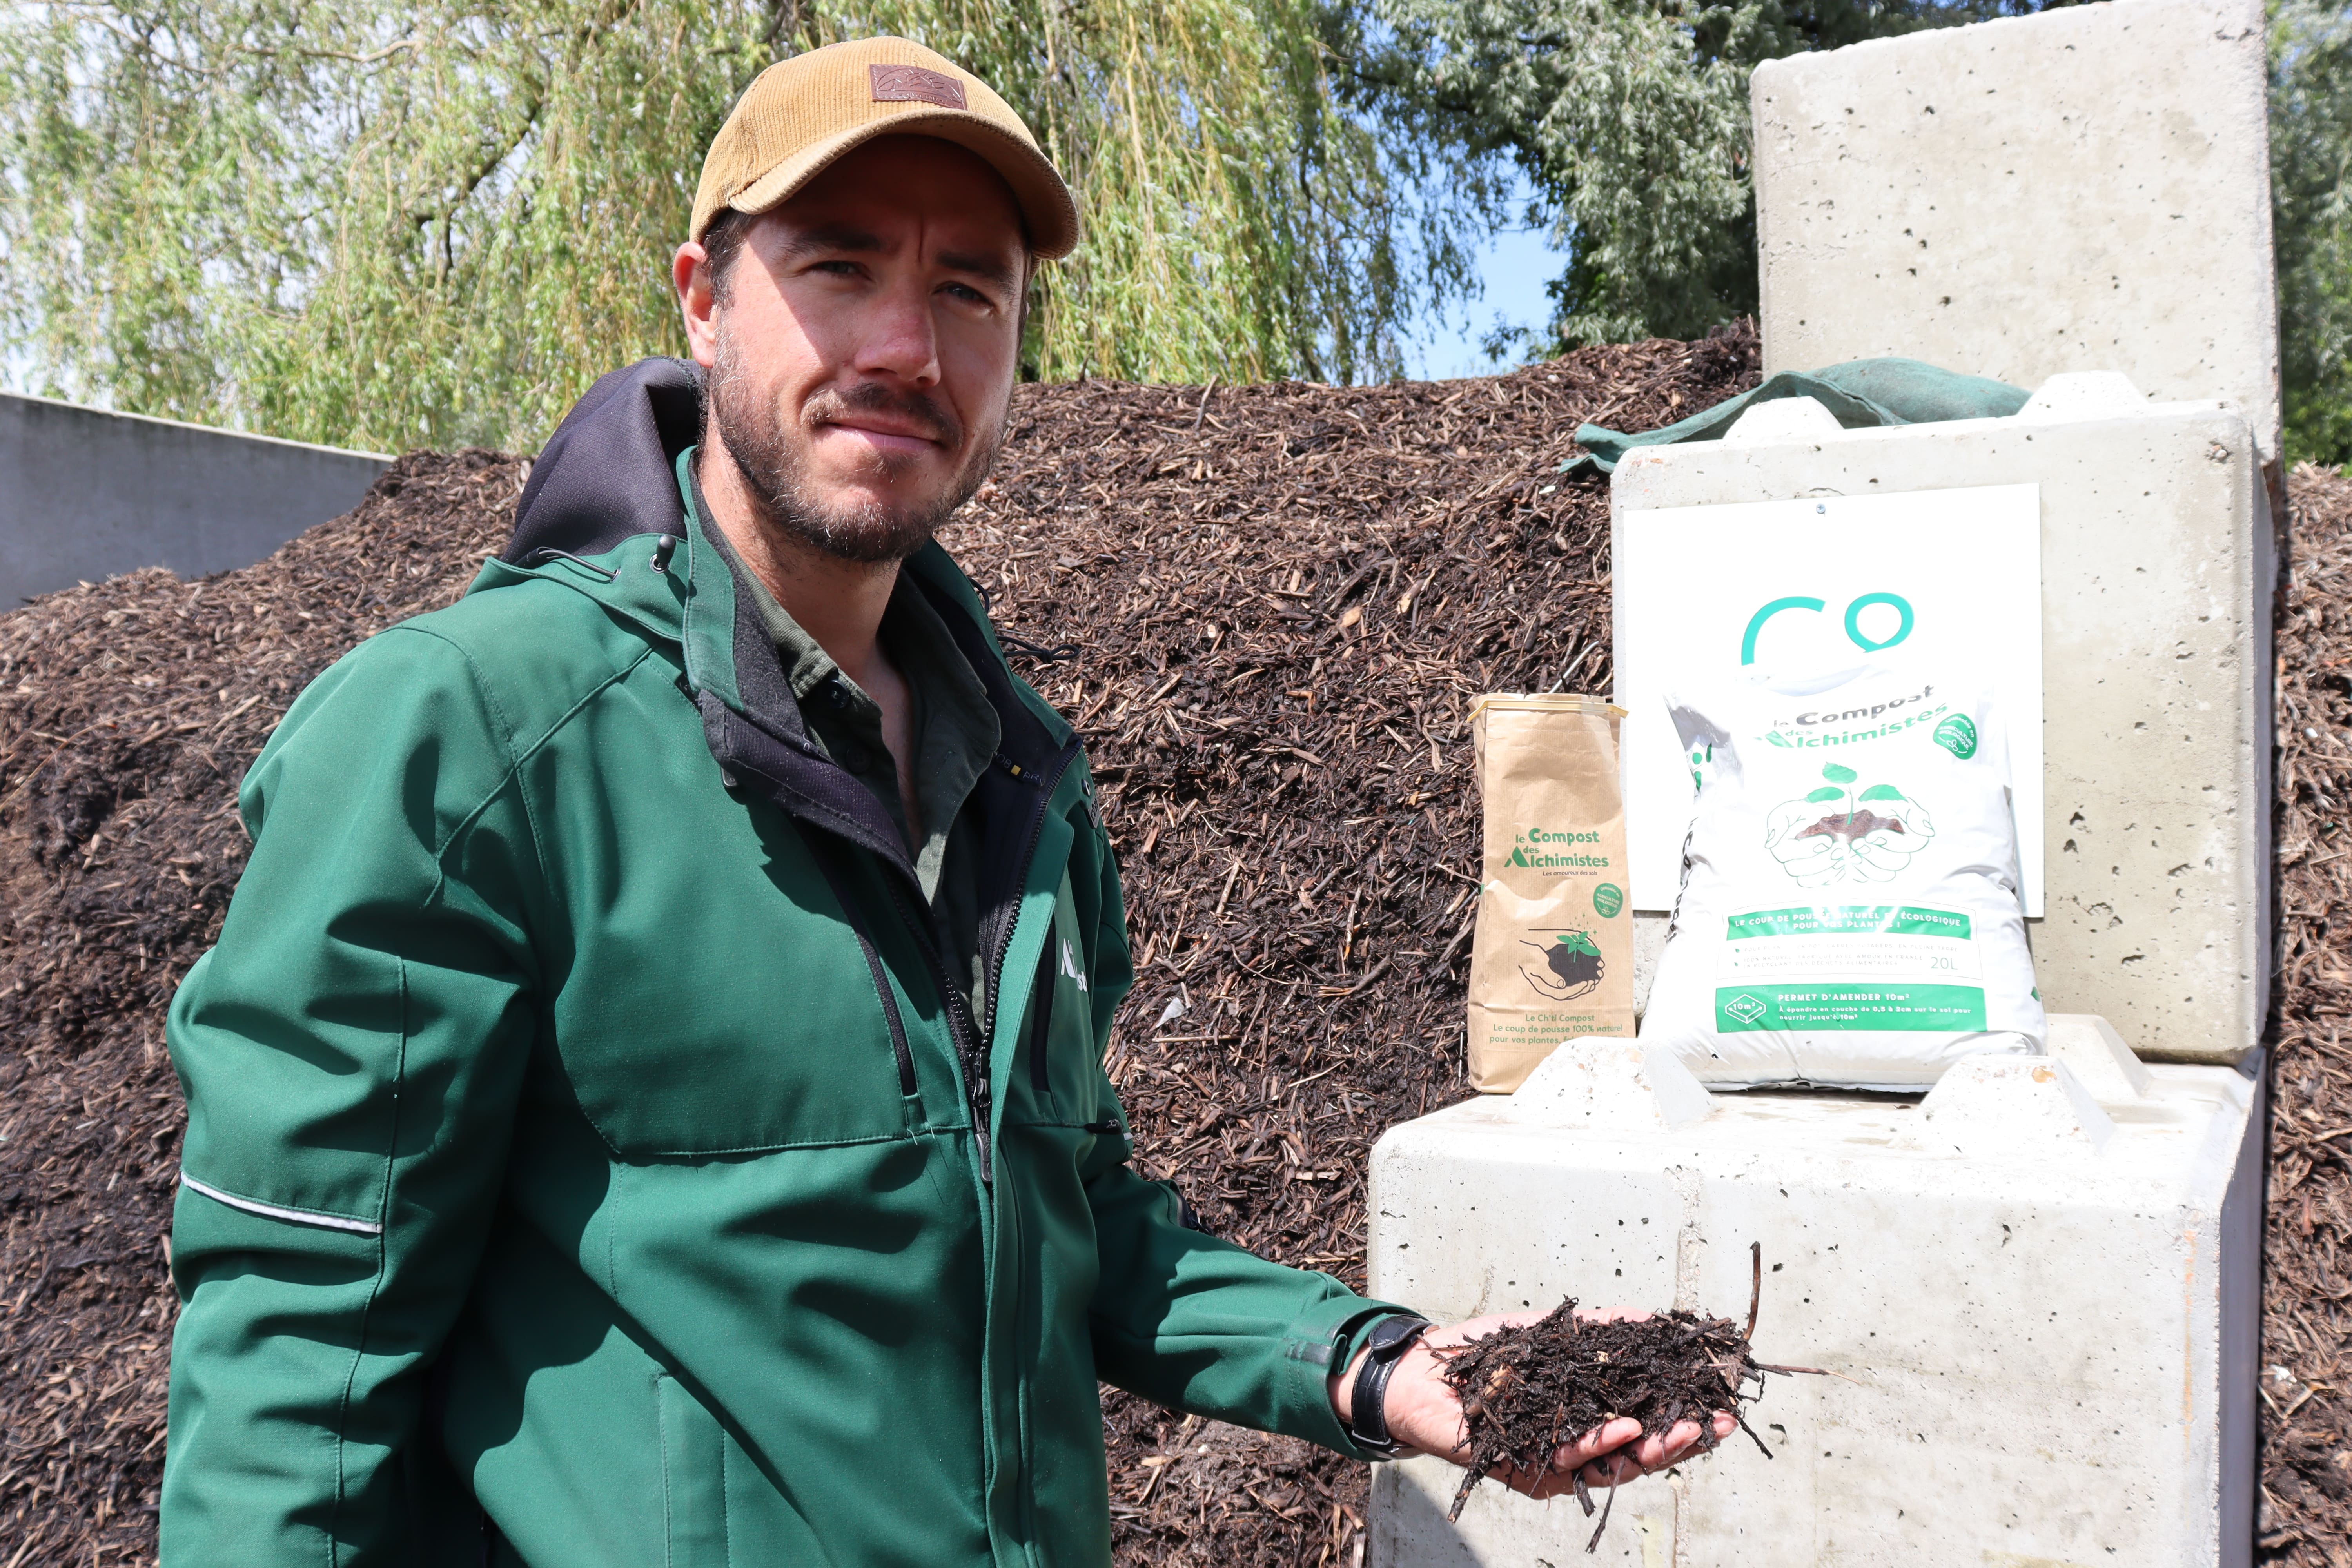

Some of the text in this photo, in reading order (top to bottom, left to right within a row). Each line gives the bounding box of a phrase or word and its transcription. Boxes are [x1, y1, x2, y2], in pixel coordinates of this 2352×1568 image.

[1796, 684, 1934, 726] Compost
[1753, 702, 1948, 748] Alchimistes
[1939, 726, 1973, 747] AGRICULTURE
[1939, 730, 1969, 750] BIOLOGIQUE
[1516, 828, 1600, 847] le Compost
[1504, 846, 1609, 867] Alchimistes
[1523, 846, 1539, 854] des
[1597, 893, 1620, 905] AGRICULTURE
[1597, 898, 1618, 909] BIOLOGIQUE
[1793, 921, 1818, 929] POUR
[1900, 911, 1960, 926] ÉCOLOGIQUE
[1931, 957, 1958, 970] 20L
[1559, 1014, 1595, 1023] Compost
[1597, 1024, 1622, 1032] naturel
[1528, 1037, 1561, 1045] plantes,
